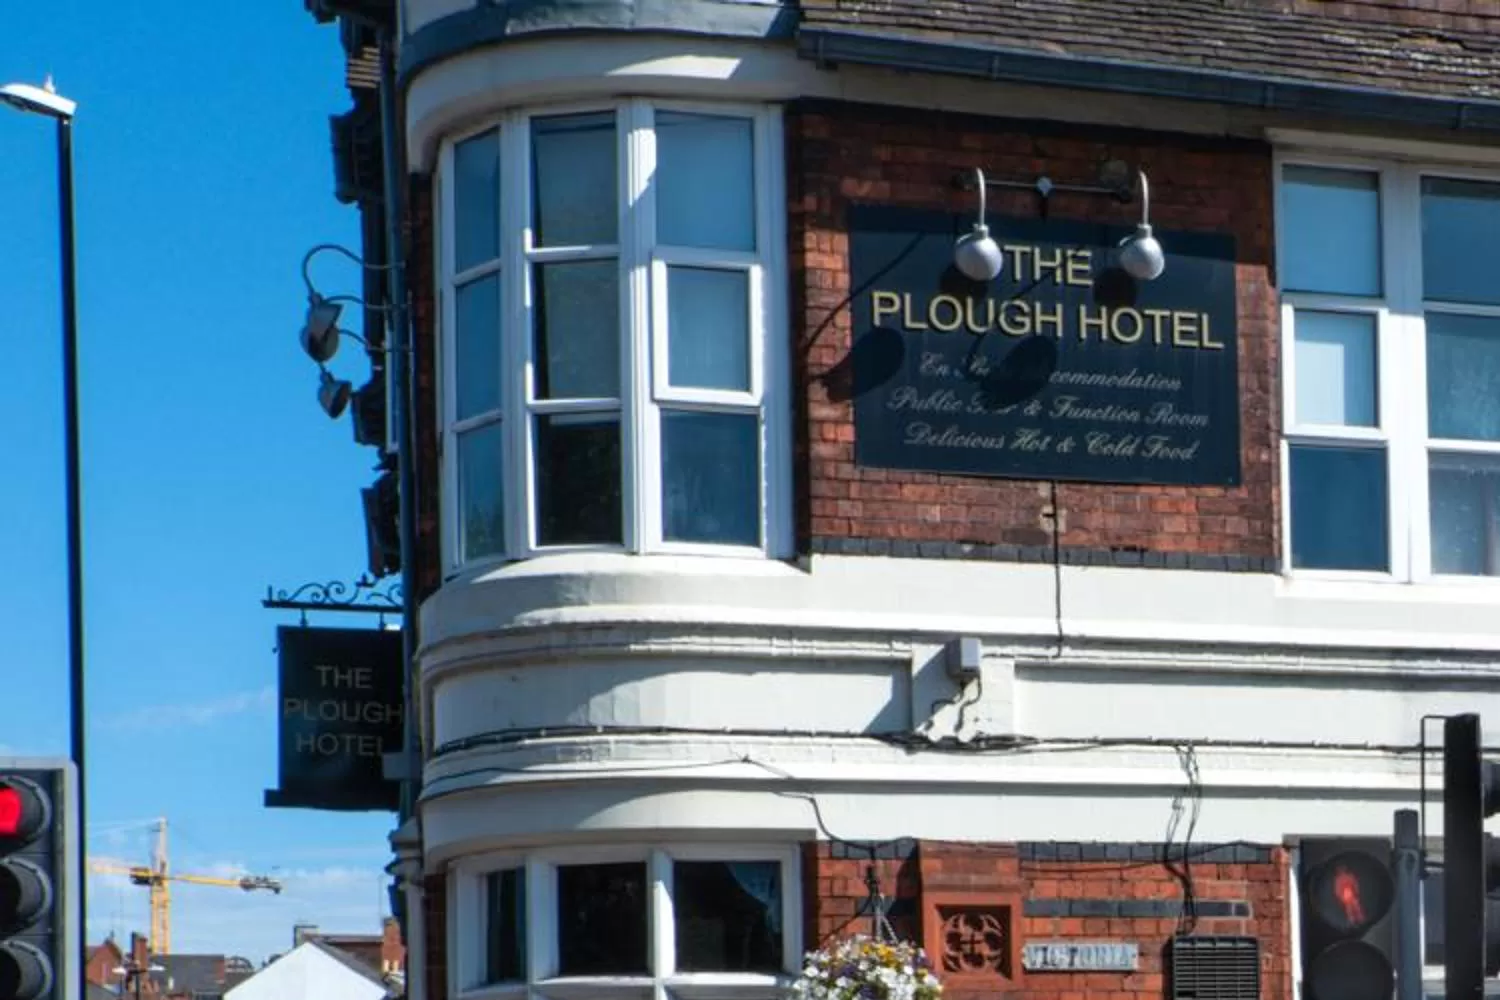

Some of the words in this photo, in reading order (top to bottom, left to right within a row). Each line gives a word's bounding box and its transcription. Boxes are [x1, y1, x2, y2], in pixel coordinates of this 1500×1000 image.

[1003, 243, 1094, 286] THE
[872, 290, 1064, 338] PLOUGH
[1078, 302, 1225, 349] HOTEL
[1047, 367, 1182, 391] commodation
[887, 385, 963, 412] Public
[1023, 399, 1043, 416] &
[1049, 395, 1141, 421] Function
[1145, 402, 1209, 426] Room
[903, 421, 1005, 449] Delicious
[1010, 428, 1052, 451] Hot
[1056, 436, 1077, 453] &
[1084, 431, 1142, 456] Cold
[1141, 435, 1200, 460] Food
[314, 665, 373, 689] THE
[284, 697, 403, 725] PLOUGH
[295, 731, 385, 757] HOTEL
